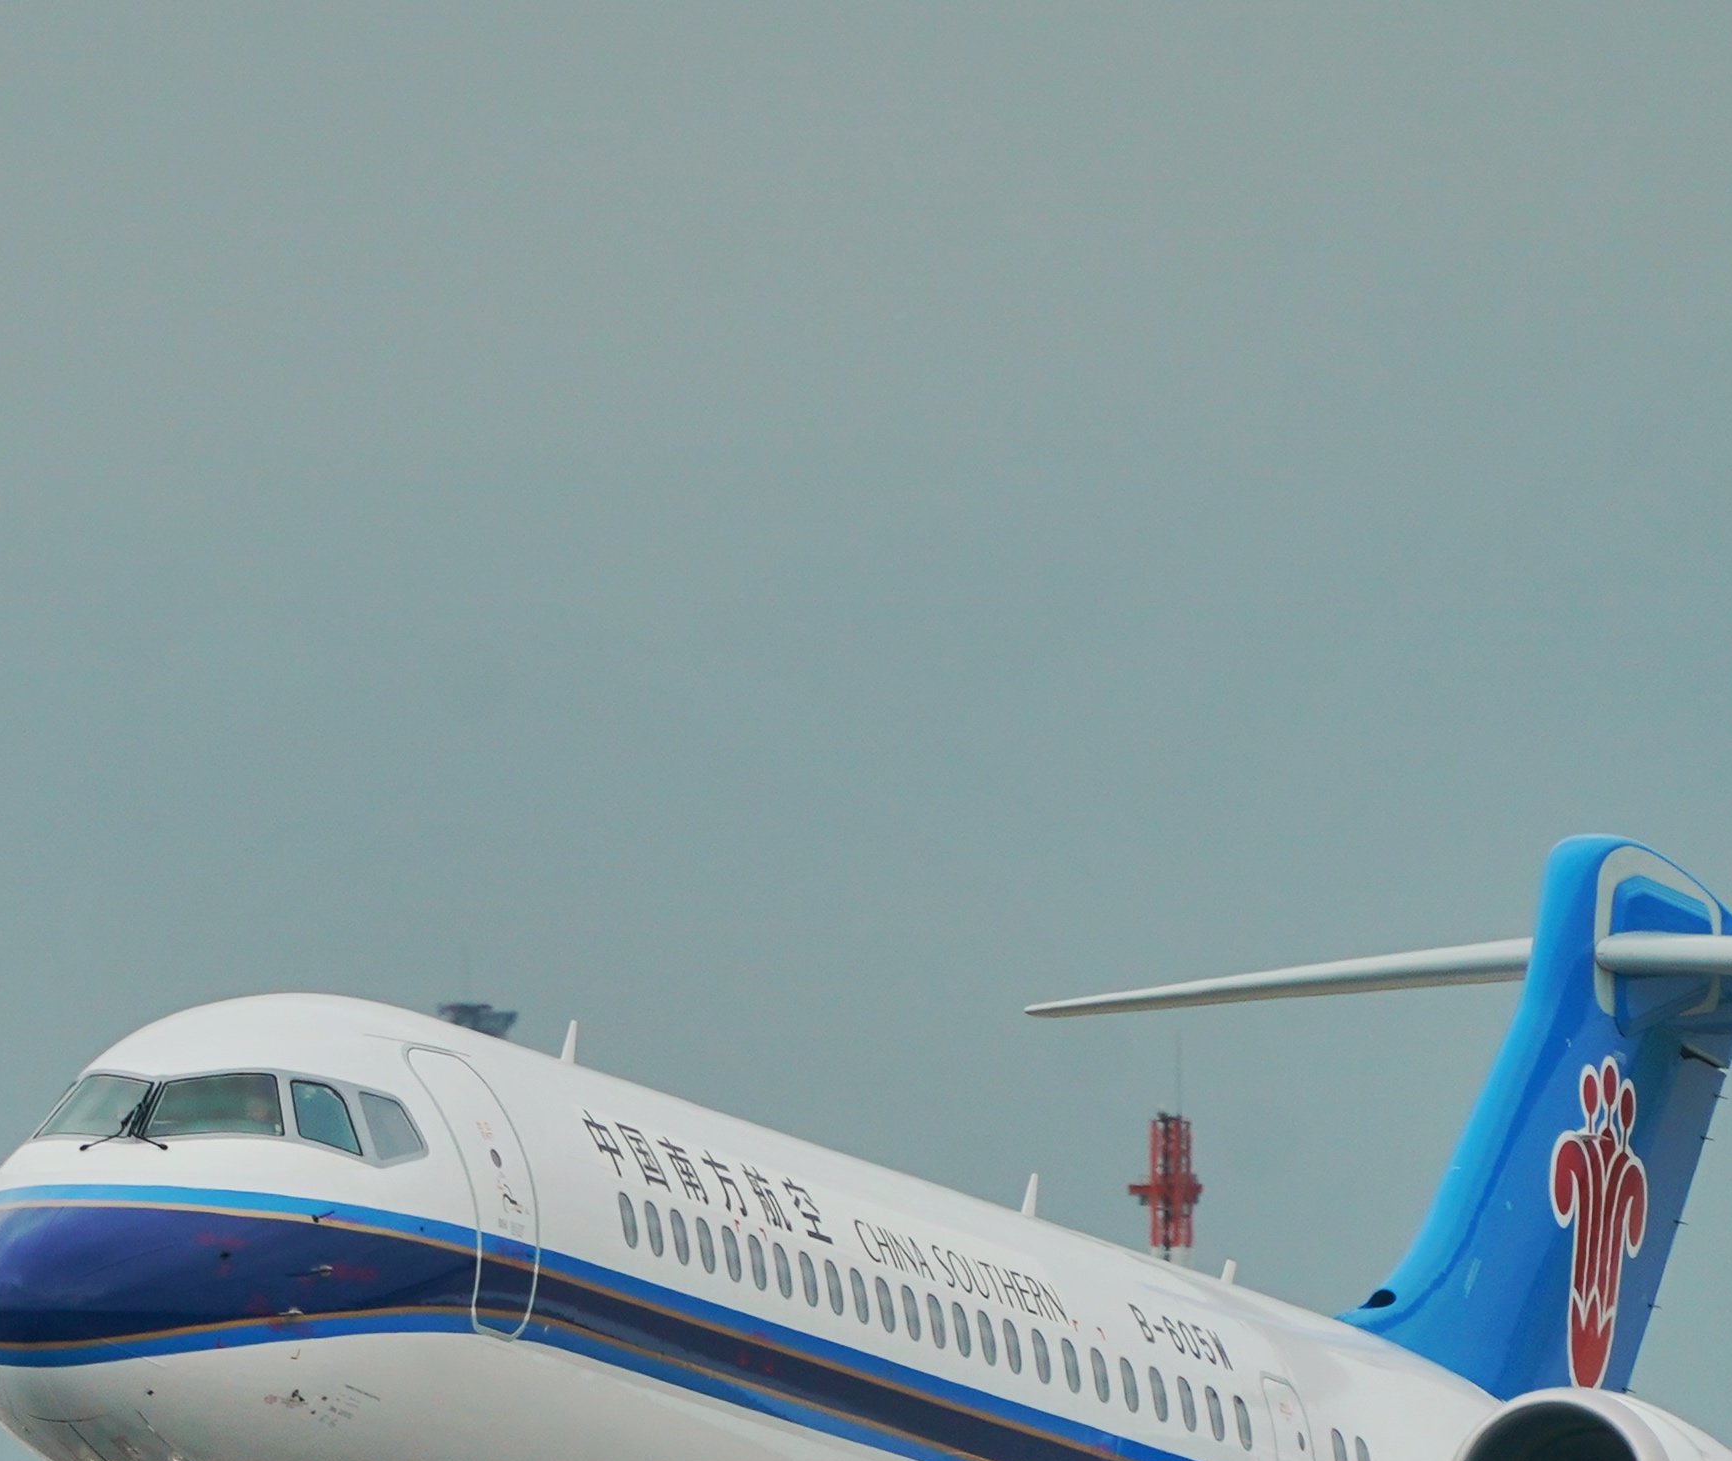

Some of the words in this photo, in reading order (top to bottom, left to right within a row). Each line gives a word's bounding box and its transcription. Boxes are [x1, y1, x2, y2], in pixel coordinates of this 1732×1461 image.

[582, 1108, 833, 1245] 中国南方航空
[854, 1219, 936, 1281] CHINA
[931, 1244, 1070, 1325] SOUTHERN
[1127, 1303, 1234, 1371] B-605W
